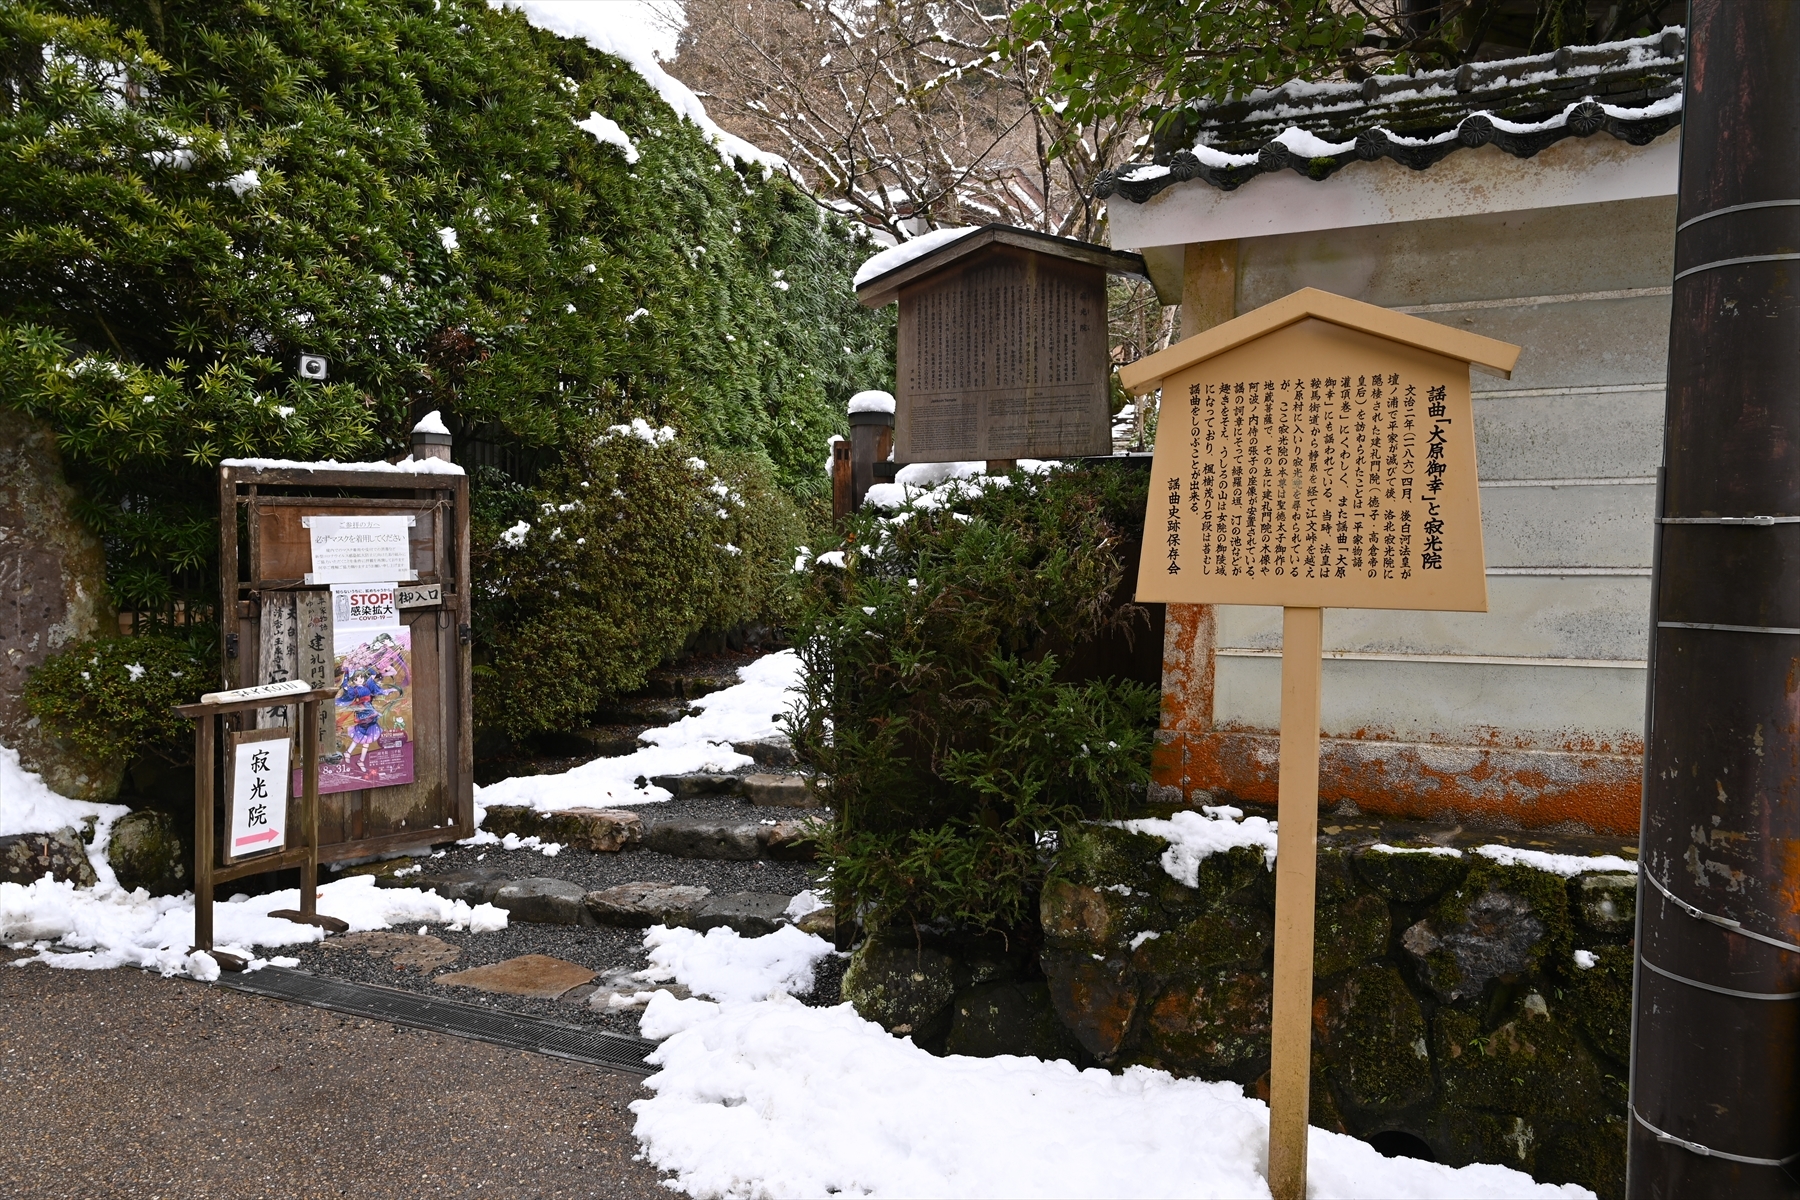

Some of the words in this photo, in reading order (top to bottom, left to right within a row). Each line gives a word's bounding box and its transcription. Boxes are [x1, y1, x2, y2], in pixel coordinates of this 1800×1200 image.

[1421, 385, 1452, 570] 謡曲「大原御幸」と寂光院
[315, 534, 406, 544] 必ずマスクを着用してください
[339, 521, 381, 529] ご参拝の方へ
[1166, 477, 1181, 576] 謡曲史跡保存会
[350, 592, 393, 606] STOP!
[350, 604, 393, 617] 感染拡大
[398, 588, 439, 604] 御入口
[305, 599, 314, 628] ゆかりの
[317, 597, 329, 631] 平家物語
[286, 607, 297, 656] 天台宗
[247, 748, 271, 828] 寂光院
